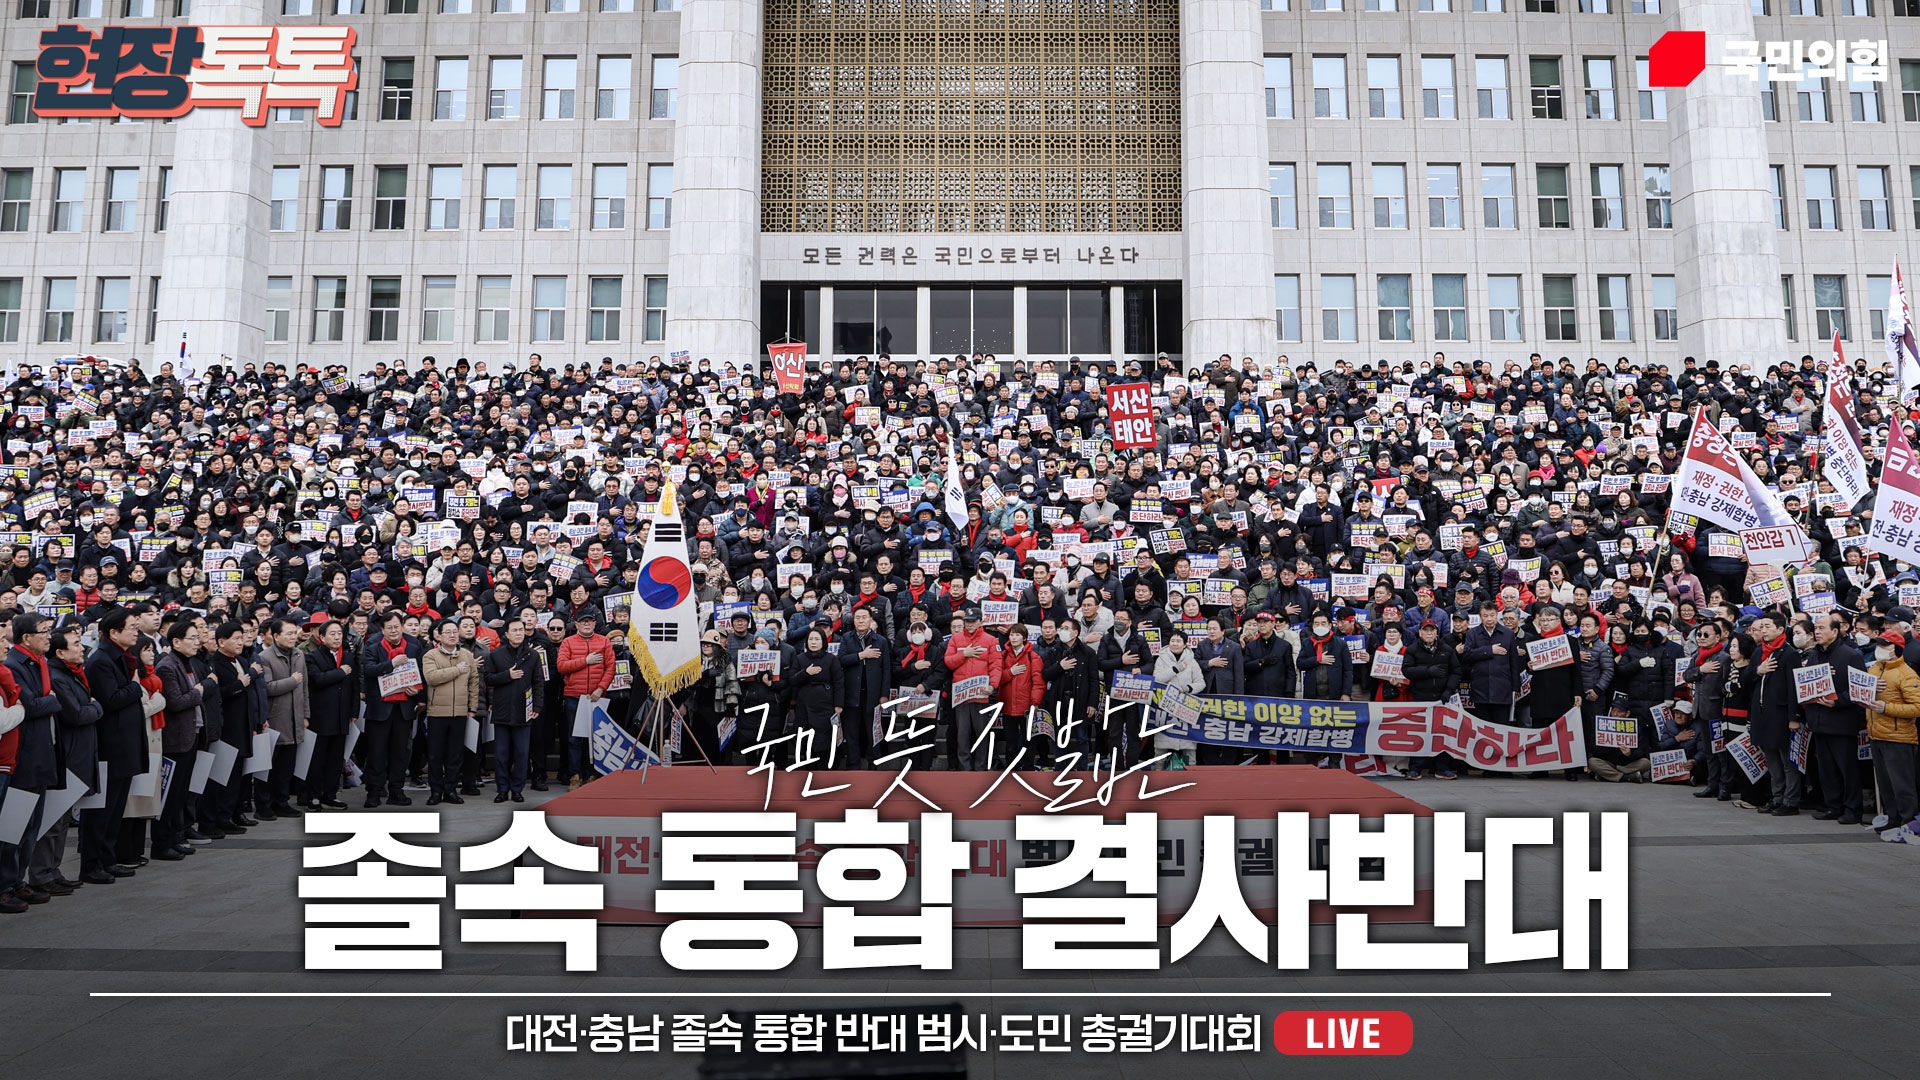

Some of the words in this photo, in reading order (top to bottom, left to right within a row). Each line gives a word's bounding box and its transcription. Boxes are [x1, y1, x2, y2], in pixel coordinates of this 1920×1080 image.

[803, 247, 842, 265] 모든
[858, 247, 918, 265] 권력은
[935, 247, 1061, 265] 국민으로부터
[1077, 246, 1139, 265] 나온다
[1111, 388, 1149, 416] 서산
[1114, 417, 1153, 444] 태안
[1743, 530, 1785, 550] 천안갑
[1786, 529, 1796, 546] 1
[1253, 702, 1302, 726] 이양
[1309, 706, 1357, 727] 없는
[1258, 725, 1354, 749] 강제합병
[1378, 706, 1574, 769] 중단하라
[1598, 732, 1614, 745] 결사
[1616, 734, 1637, 746] 반대!
